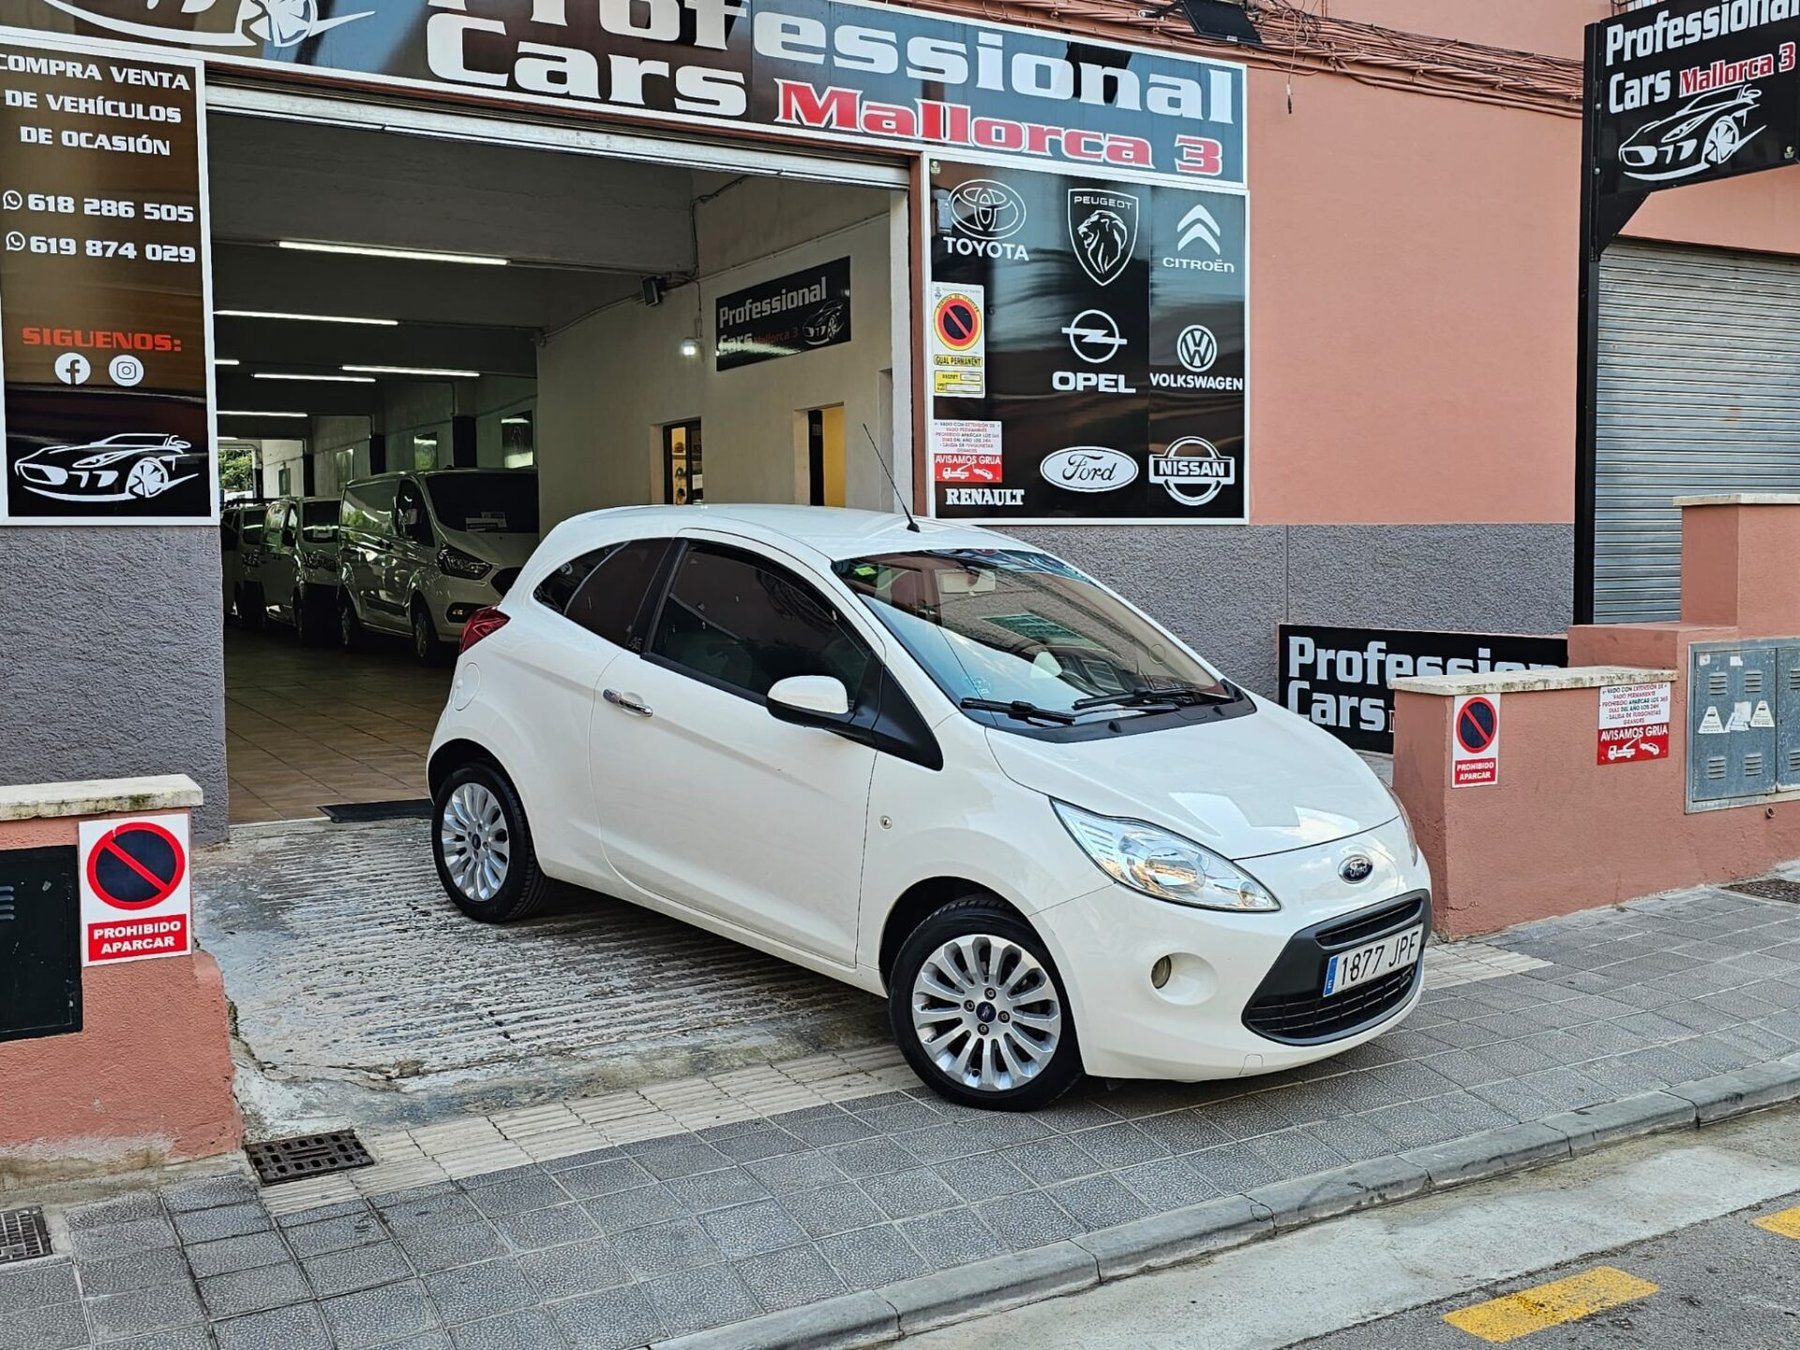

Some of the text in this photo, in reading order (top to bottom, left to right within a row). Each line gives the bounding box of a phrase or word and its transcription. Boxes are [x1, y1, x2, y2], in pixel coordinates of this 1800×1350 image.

[110, 66, 191, 91] VENTA
[1609, 41, 1796, 114] Cars Mallorca 3
[5, 89, 182, 124] DE VEHÍCULOS
[427, 13, 1224, 177] Cars Mallorca 3
[20, 125, 171, 156] DE OCASIÓN
[27, 193, 194, 222] 618 286 505
[1074, 195, 1132, 210] PEUGEOT
[30, 235, 196, 263] 619 874 029
[943, 236, 1029, 262] TOYOTA
[719, 276, 827, 329] Professional
[22, 327, 182, 352] SIGUENOS:
[1052, 371, 1136, 393] OPEL
[1150, 372, 1243, 391] VOLKSWAGEN
[935, 455, 1001, 465] AVISAMOS GRUA
[1062, 453, 1118, 481] Ford
[1158, 461, 1225, 476] NISSAN
[945, 488, 1025, 506] RENAULT
[1288, 680, 1385, 732] Cars
[1600, 724, 1669, 742] AVISAMOS GRUA
[1456, 762, 1495, 772] PROHIBIDO
[1459, 771, 1491, 781] APARCAR
[93, 921, 182, 940] PROHIBIDO
[100, 936, 176, 955] APARCAR
[1341, 930, 1419, 986] 1877 JPF
